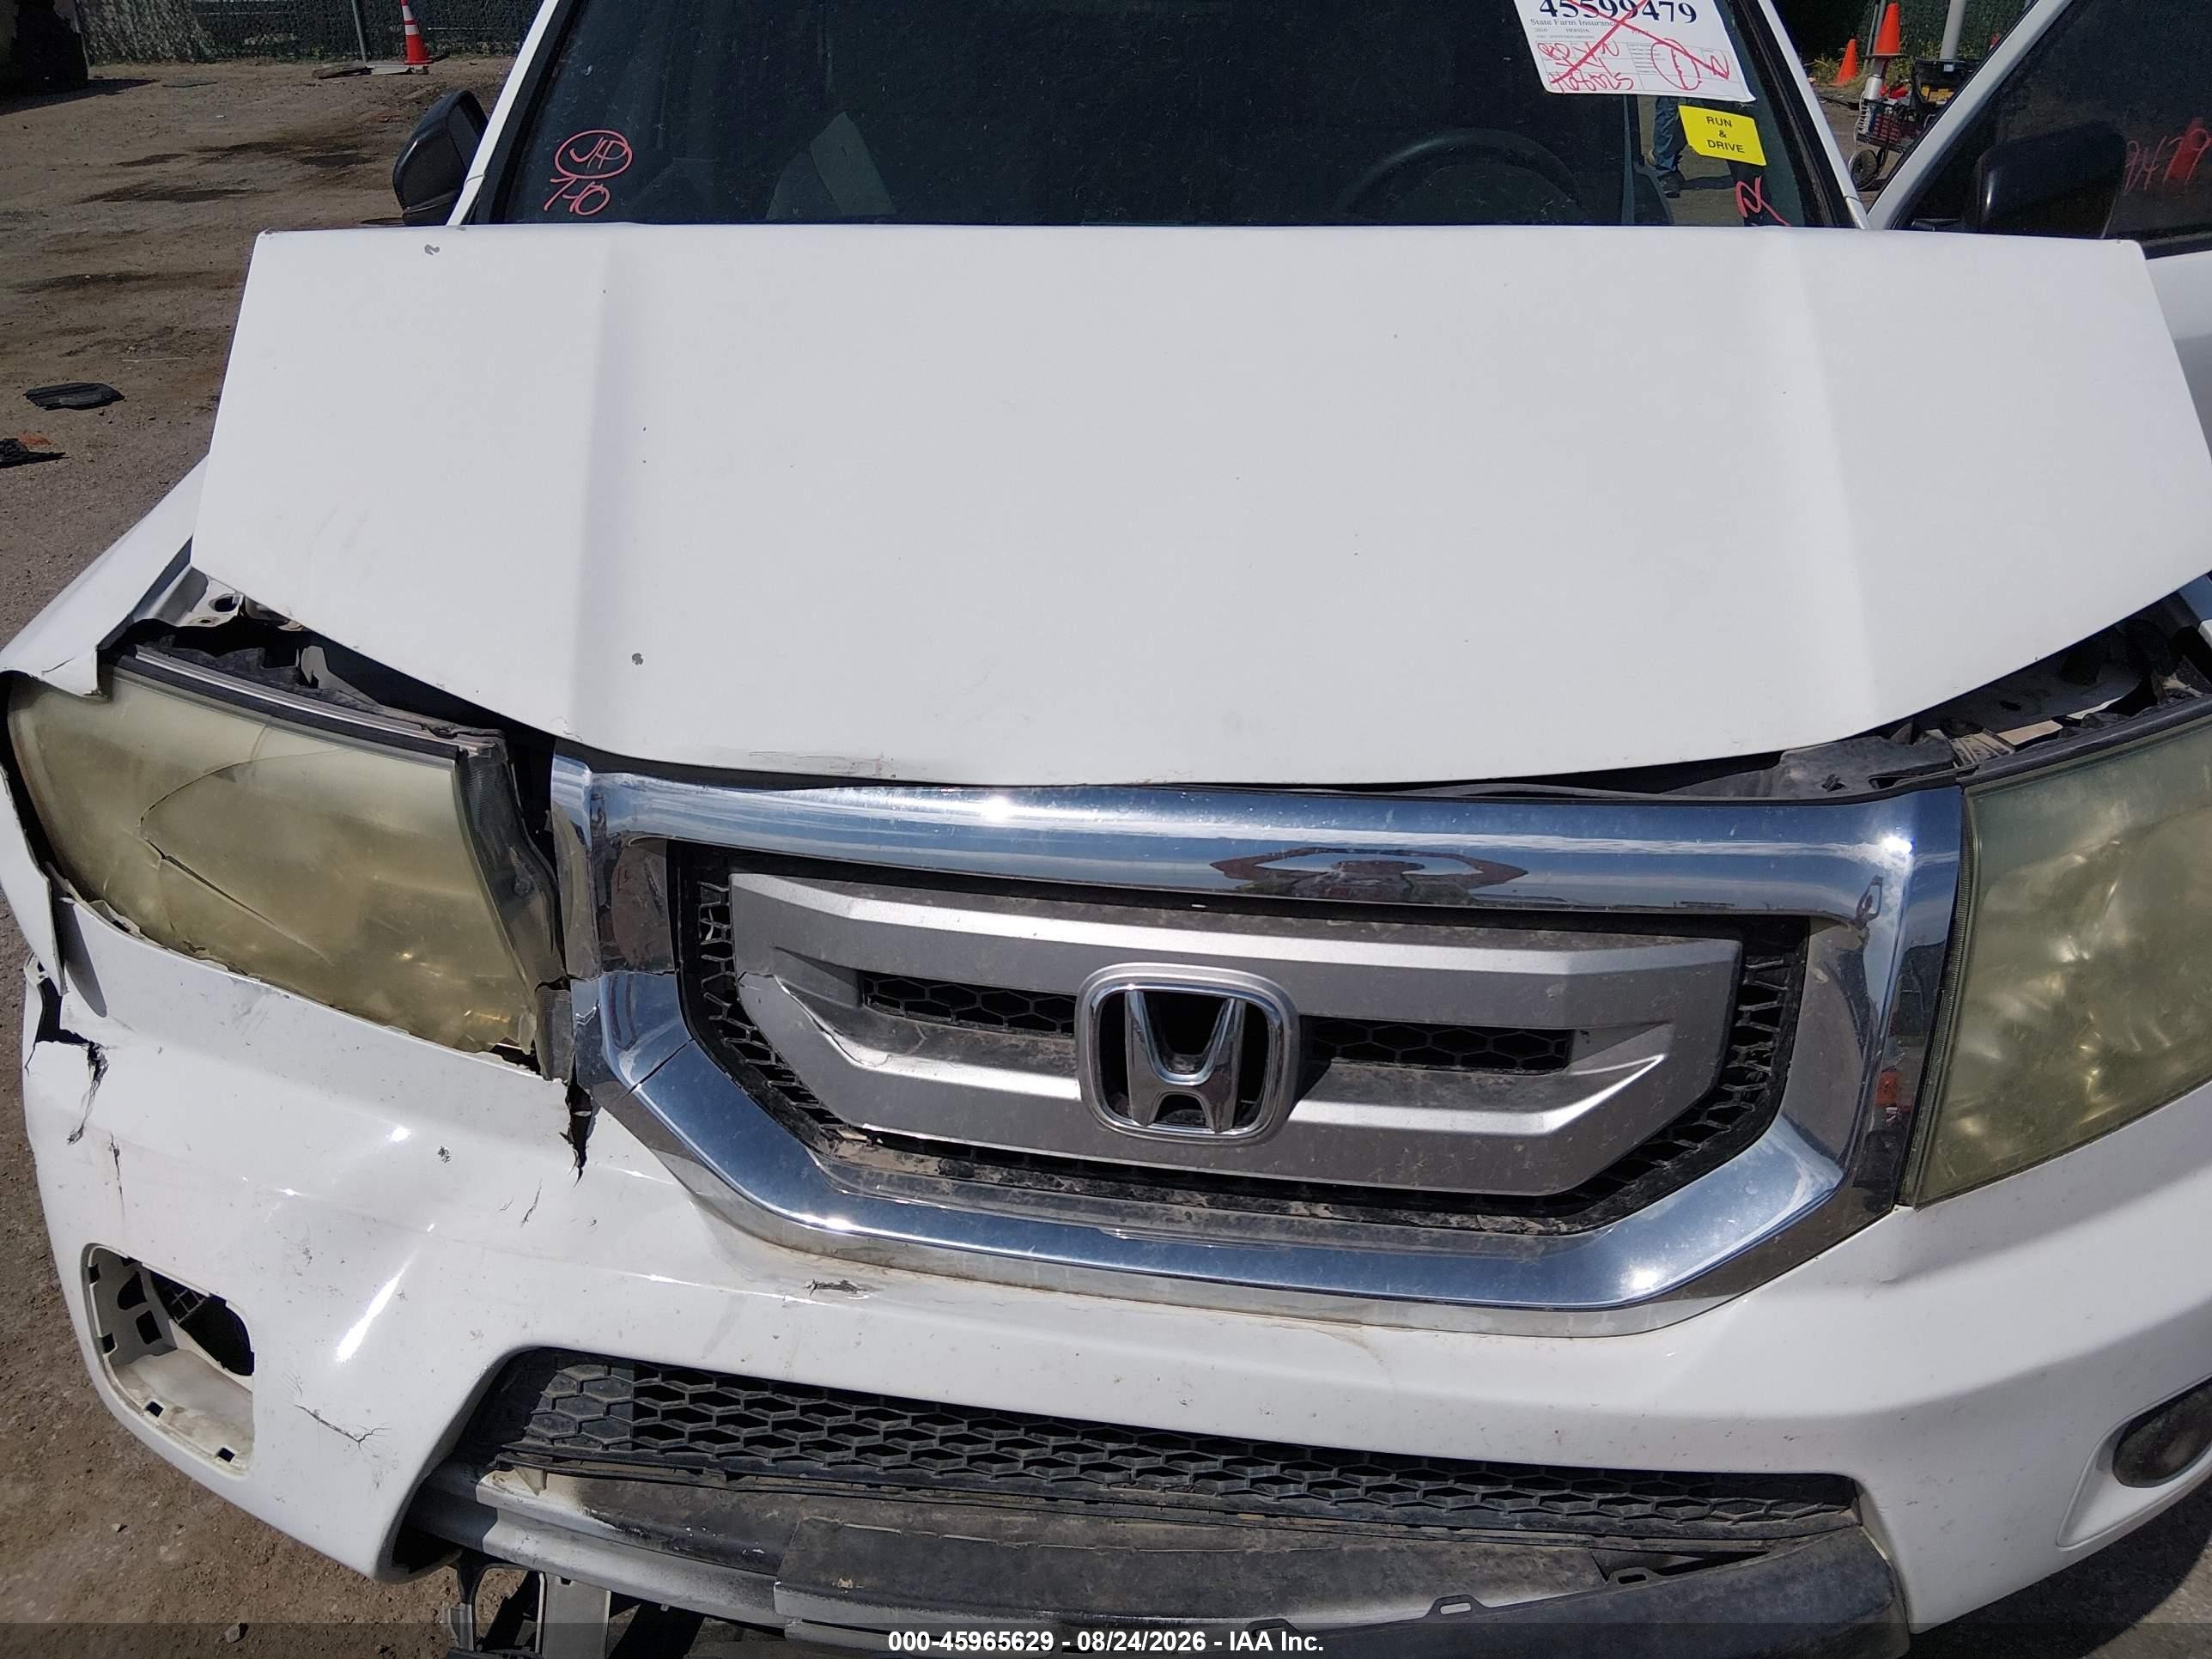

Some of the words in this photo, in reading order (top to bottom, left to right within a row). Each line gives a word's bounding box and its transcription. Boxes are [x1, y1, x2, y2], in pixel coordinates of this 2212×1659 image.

[1540, 0, 1696, 23] 45599479
[1705, 115, 1733, 128] RUN
[1718, 129, 1728, 138] &
[1706, 138, 1746, 154] DRIVE
